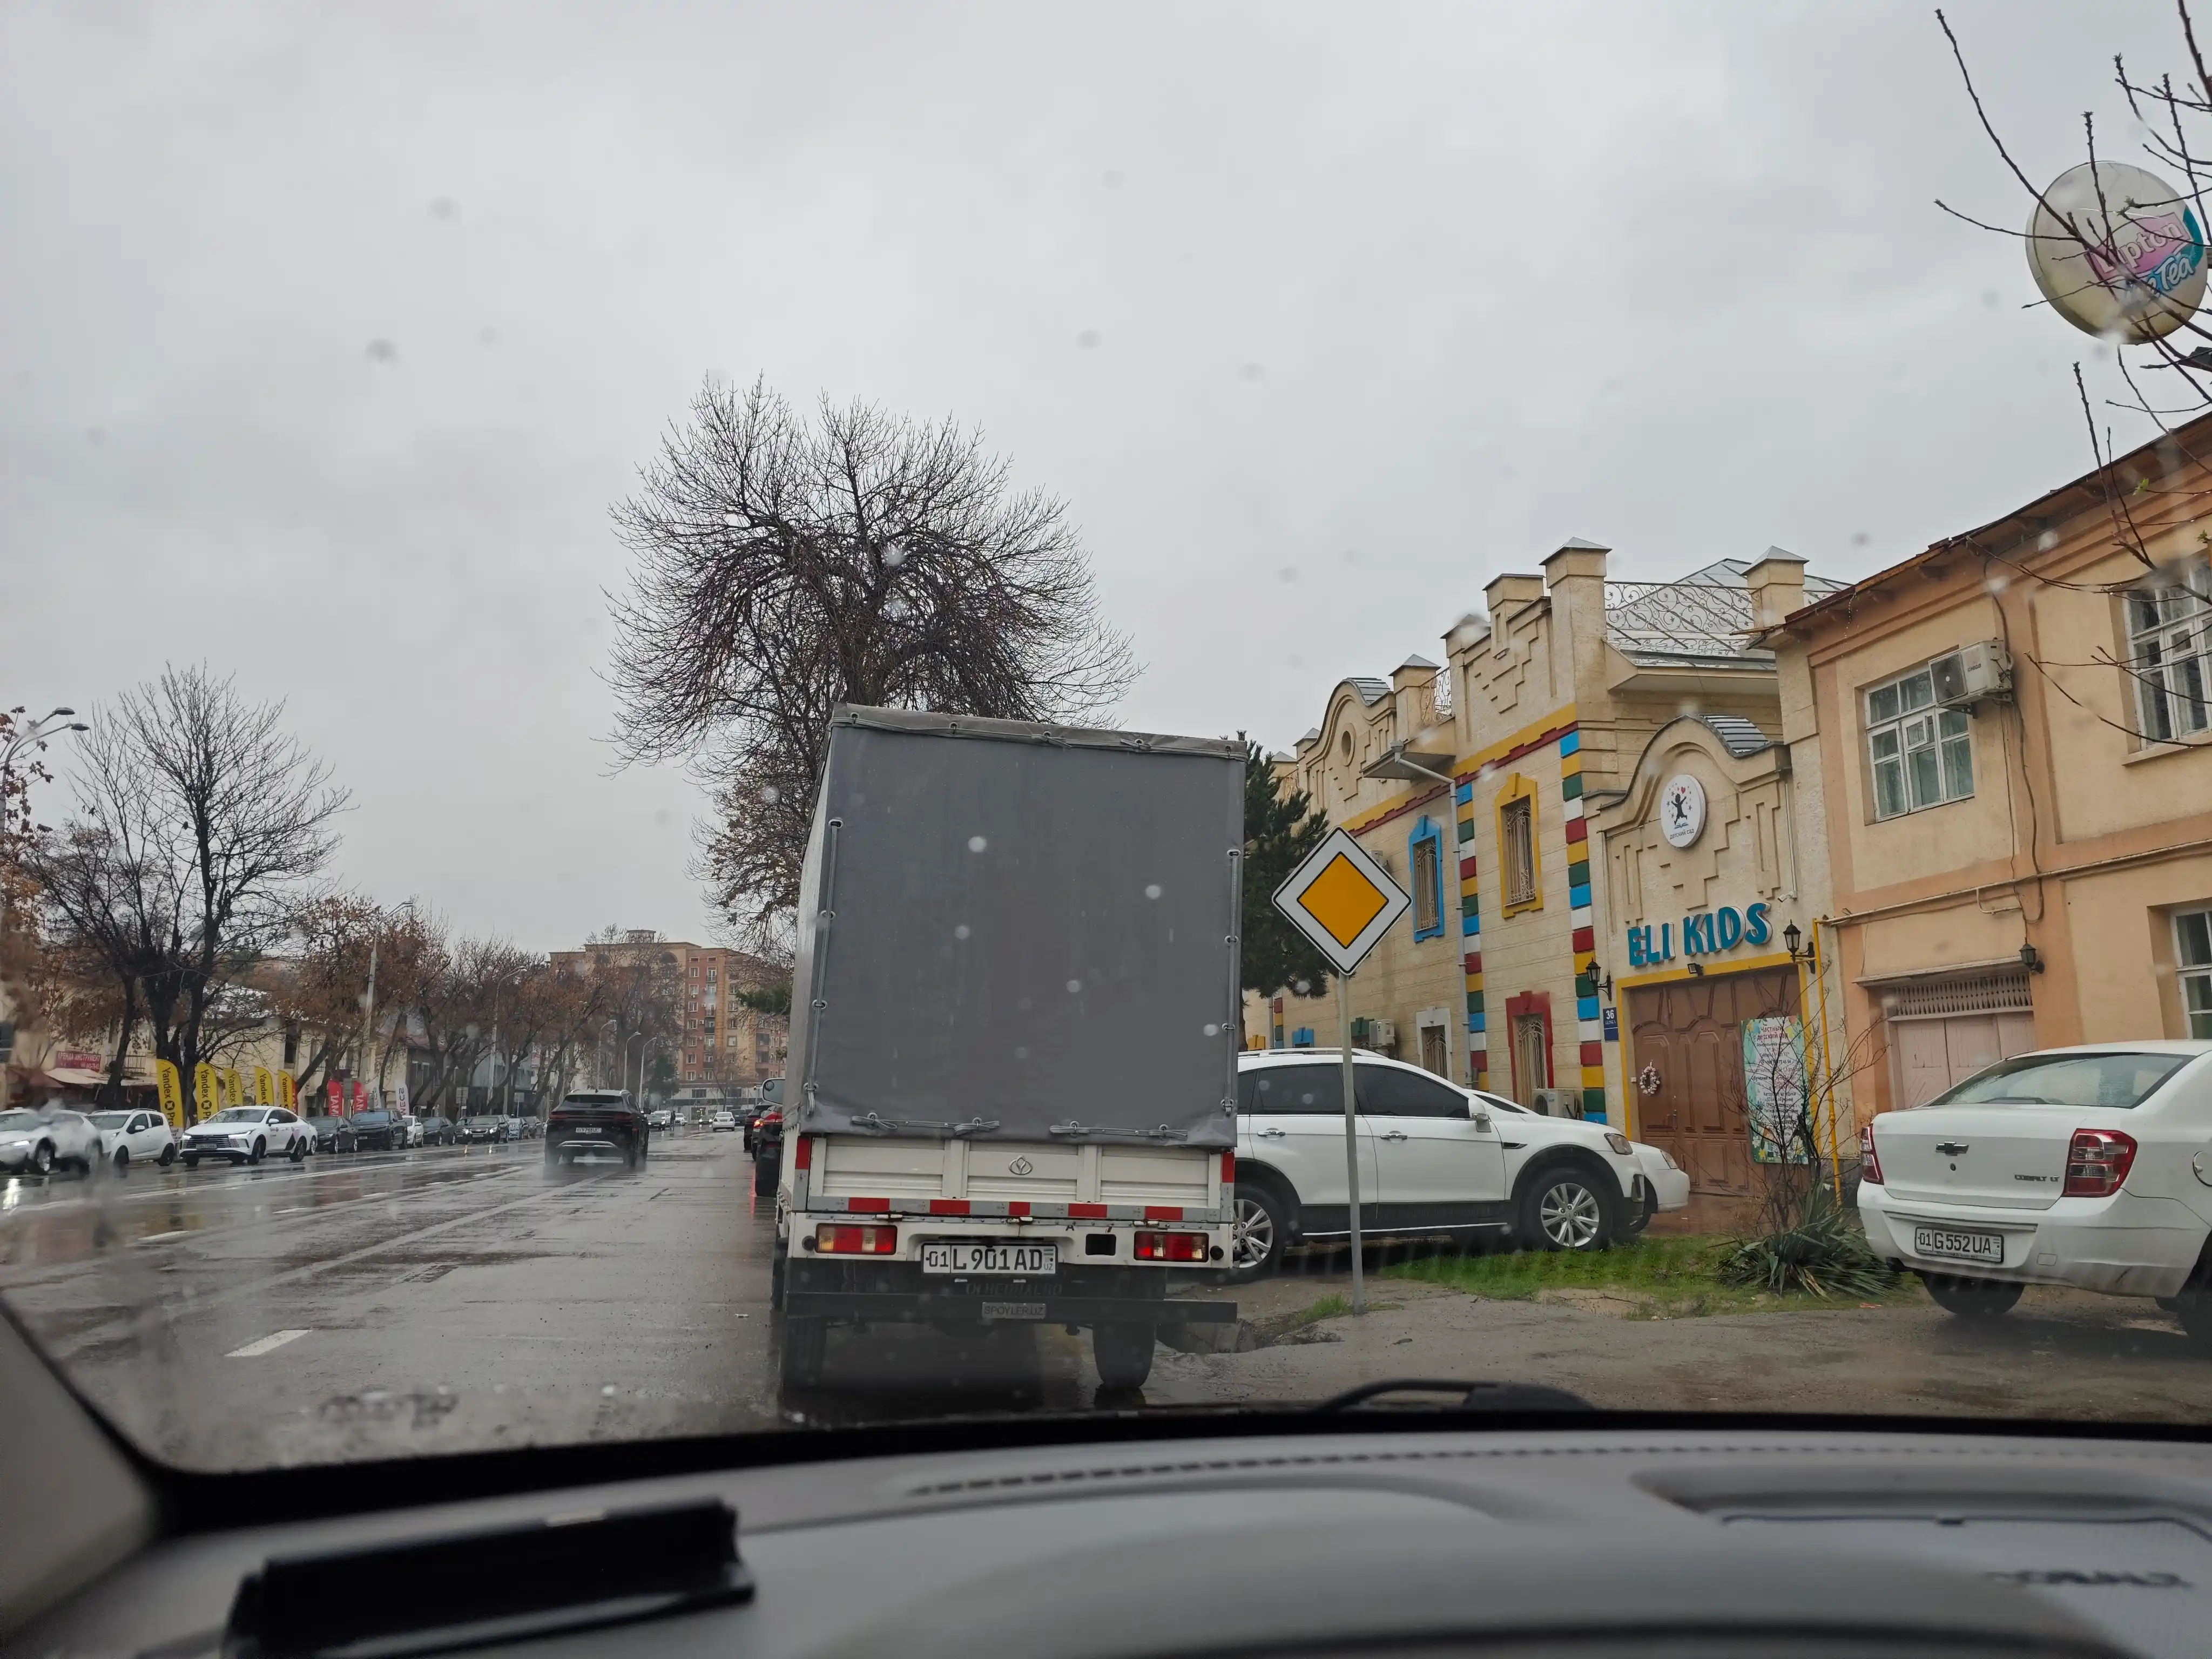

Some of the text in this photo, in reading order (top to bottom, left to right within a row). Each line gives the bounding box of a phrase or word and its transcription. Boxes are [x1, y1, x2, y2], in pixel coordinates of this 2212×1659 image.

[2155, 254, 2195, 291] Tea
[1967, 663, 1981, 672] CHIGO
[1627, 902, 1773, 967] ELI KIDS
[1606, 1009, 1614, 1020] 36
[161, 1067, 175, 1127] Yandex Pro
[200, 1069, 211, 1120] Yandex Pr
[228, 1074, 238, 1103] Yandex
[259, 1073, 268, 1101] Yandex
[1919, 1232, 1932, 1246] 01
[929, 1251, 949, 1267] 01
[1043, 1263, 1054, 1271] UZ
[984, 1305, 1044, 1316] SPOYLER.UZ
